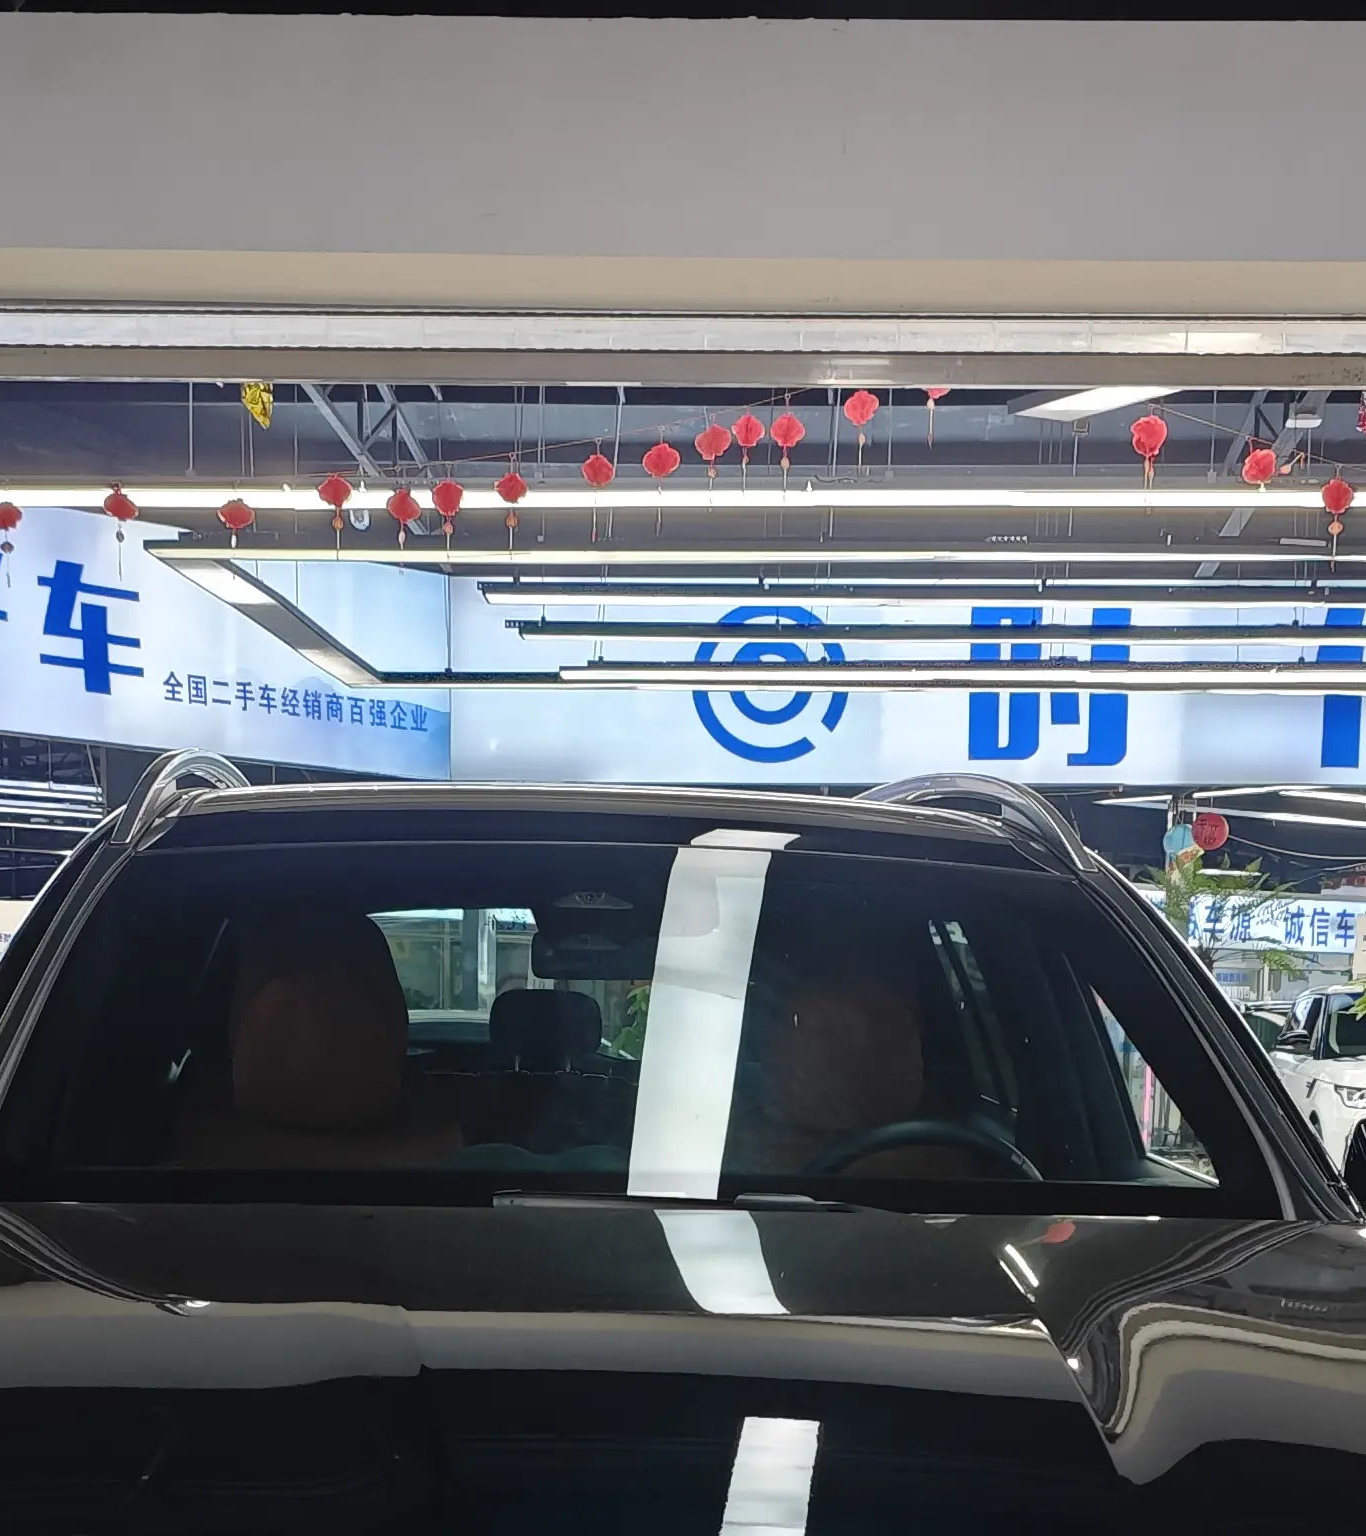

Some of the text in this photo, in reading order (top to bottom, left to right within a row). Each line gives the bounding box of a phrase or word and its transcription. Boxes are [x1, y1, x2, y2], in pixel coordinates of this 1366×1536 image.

[162, 670, 429, 733] 全国二手车经销商百强企业
